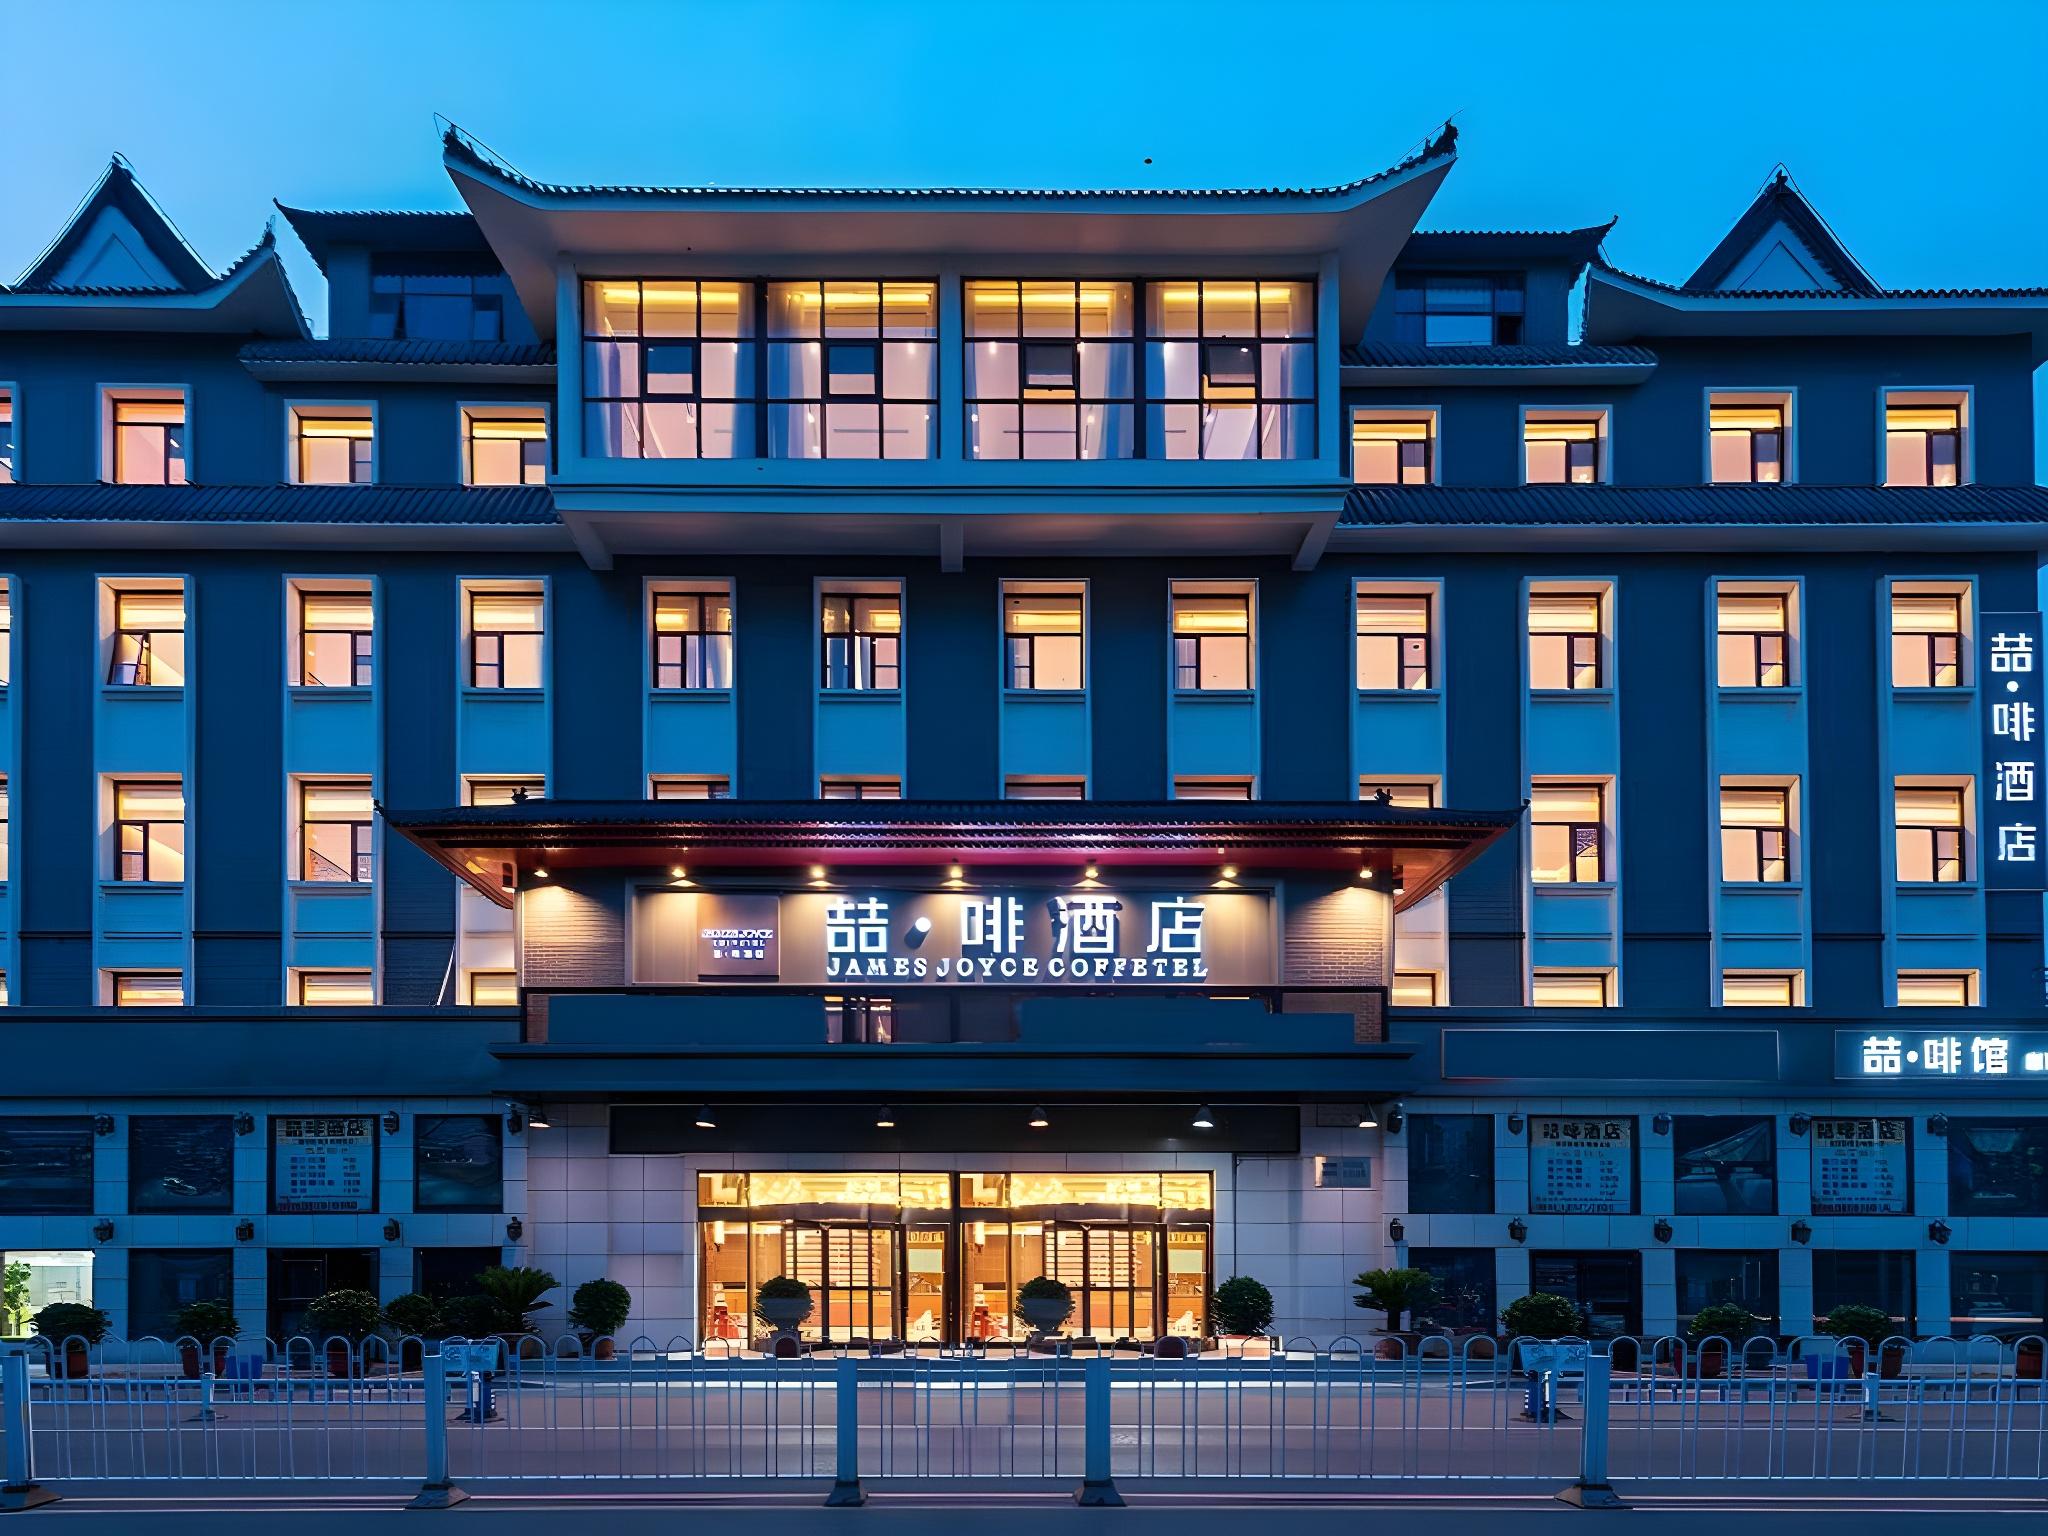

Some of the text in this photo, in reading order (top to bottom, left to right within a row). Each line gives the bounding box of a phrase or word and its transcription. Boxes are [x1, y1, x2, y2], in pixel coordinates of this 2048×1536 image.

[826, 957, 1209, 977] JAMES JOYCE COFFETEL
